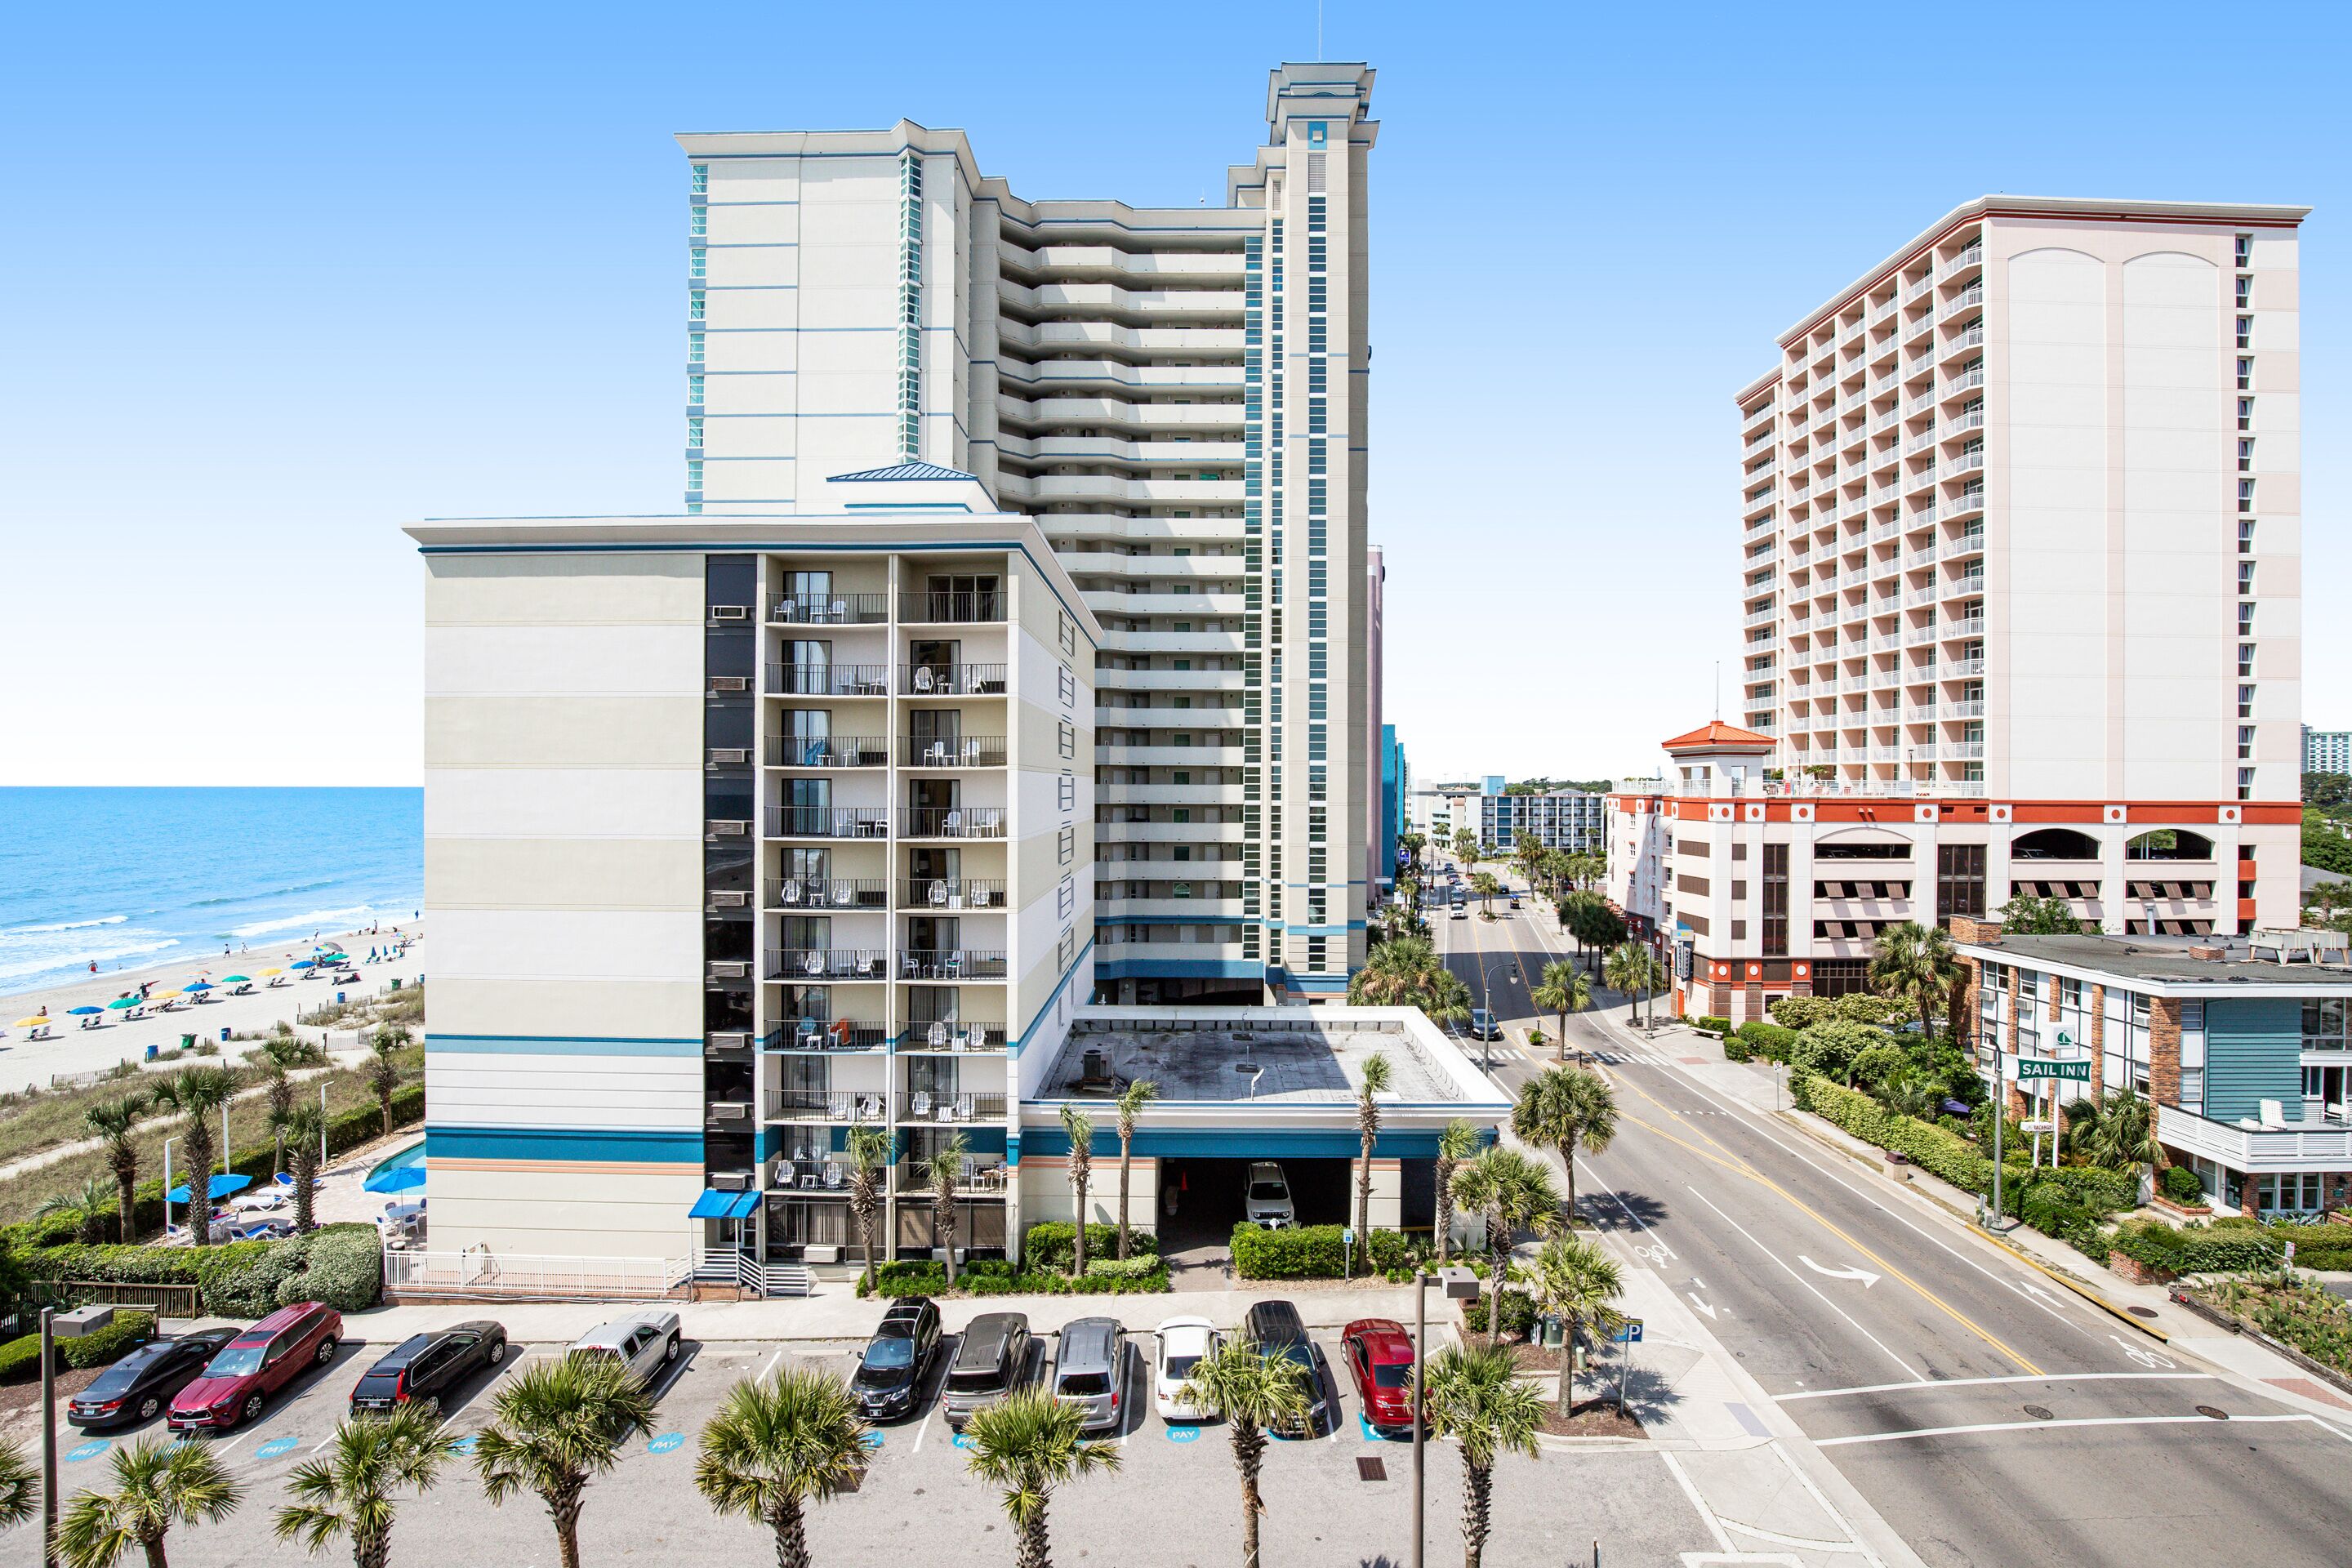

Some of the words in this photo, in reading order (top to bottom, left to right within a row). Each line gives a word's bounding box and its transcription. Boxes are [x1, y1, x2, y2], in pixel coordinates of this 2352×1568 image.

[2022, 1064, 2056, 1076] SAIL
[2060, 1065, 2087, 1076] INN
[1628, 1324, 1641, 1341] P
[261, 1446, 288, 1454] PAY
[653, 1441, 678, 1449] PAY
